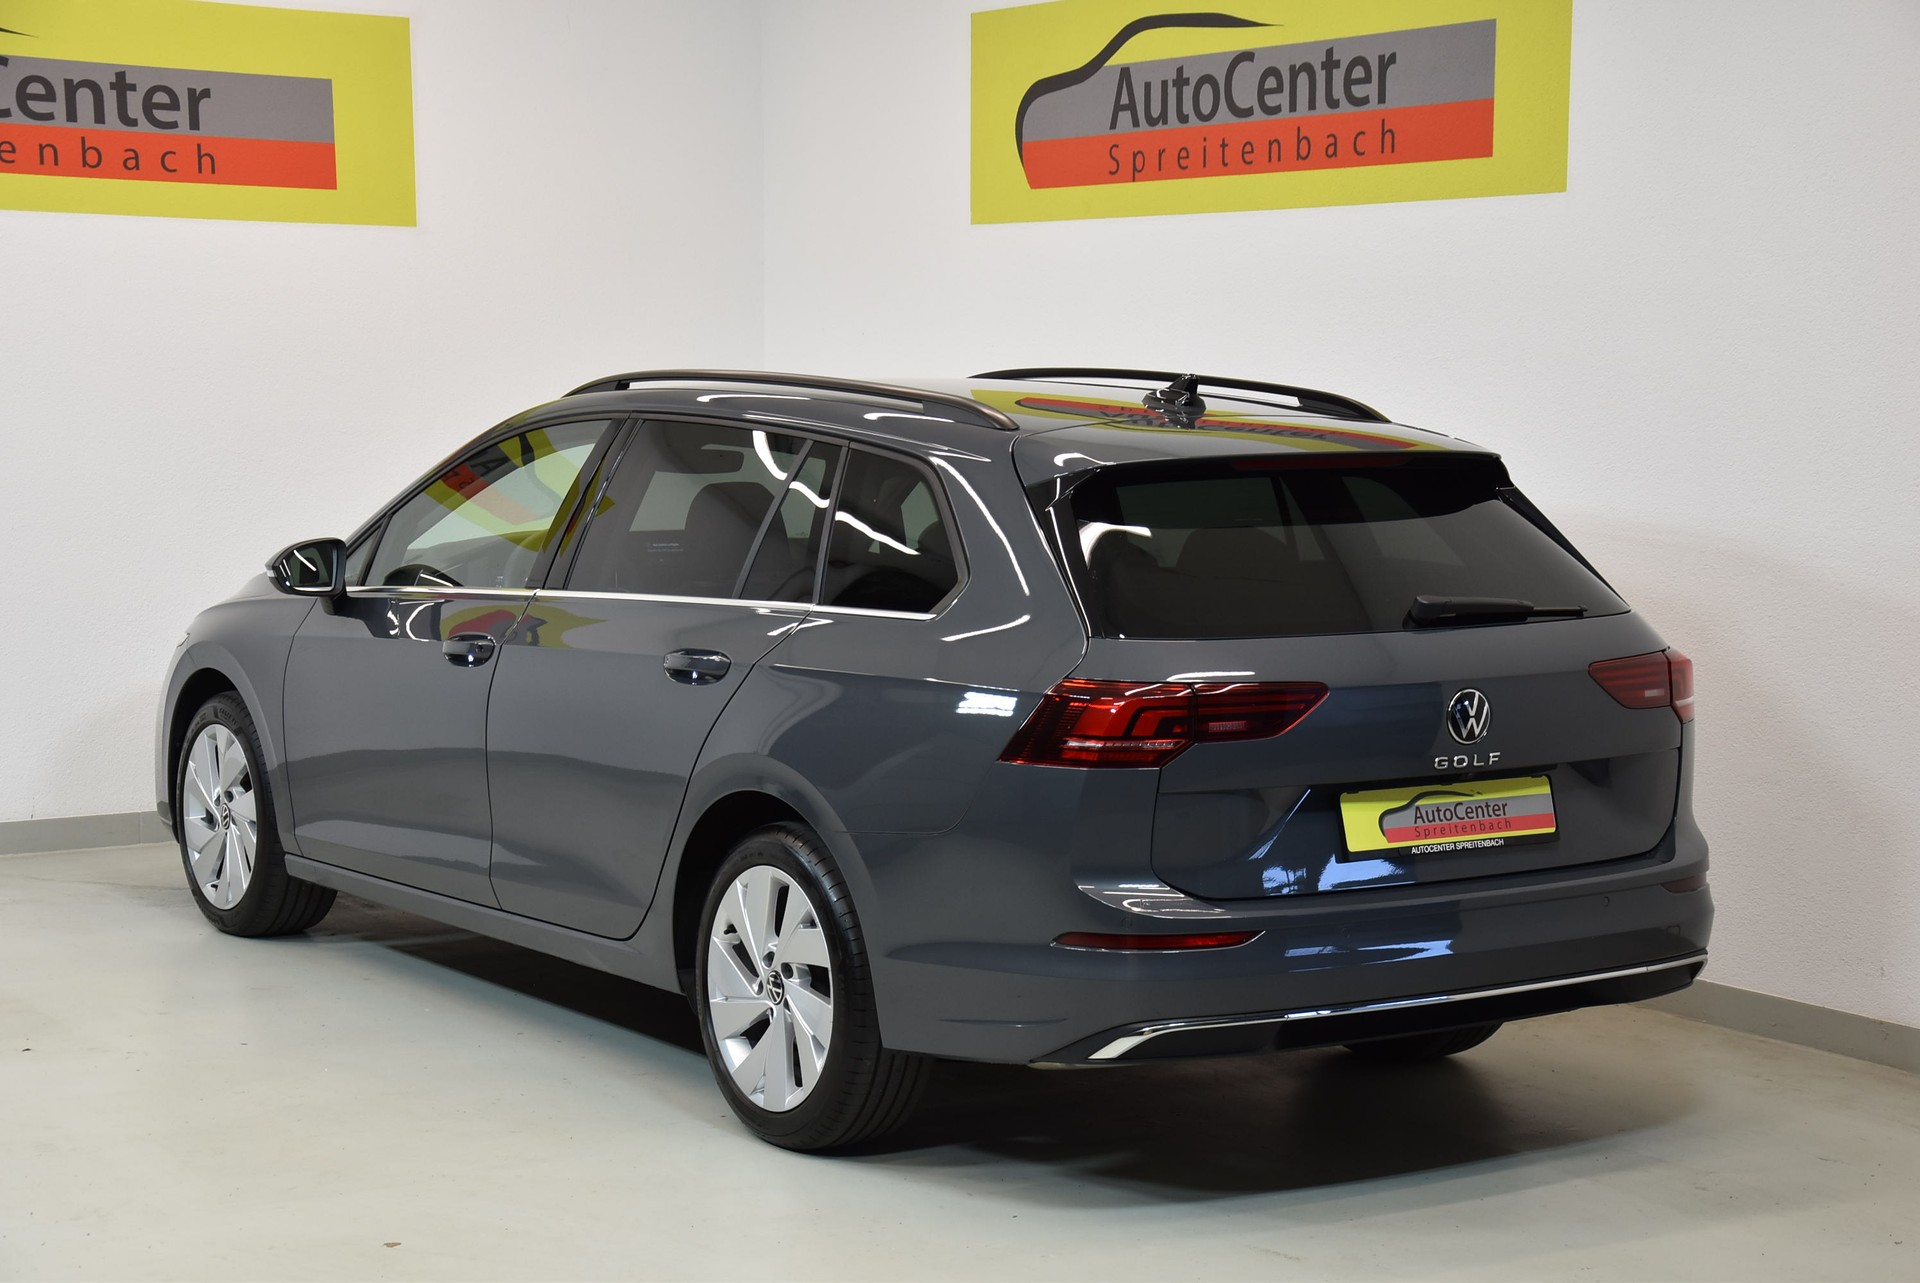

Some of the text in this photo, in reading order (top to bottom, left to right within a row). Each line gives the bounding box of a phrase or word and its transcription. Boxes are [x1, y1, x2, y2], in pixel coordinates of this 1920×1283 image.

[0, 56, 211, 131] enter
[1108, 46, 1397, 130] AutoCenter
[1107, 118, 1396, 182] Spreitenbach
[1434, 751, 1501, 770] GOLF
[1413, 801, 1508, 825] AutoCenter
[1414, 818, 1513, 839] Spreitenbach
[1411, 838, 1505, 855] AUTOCENTER SPREITENBACH
